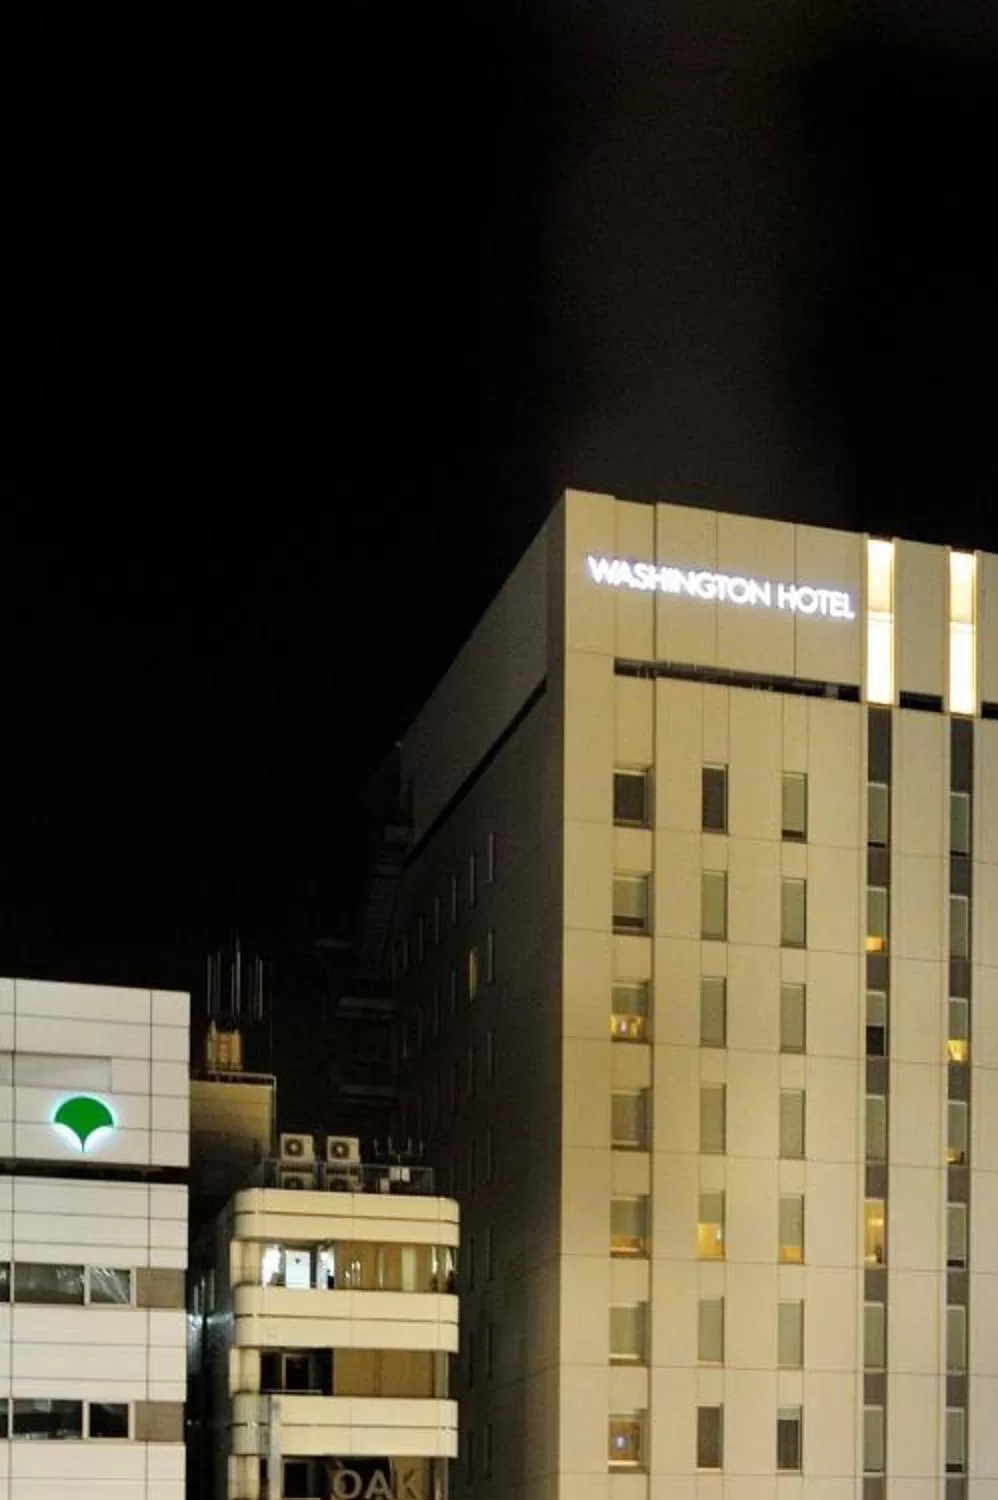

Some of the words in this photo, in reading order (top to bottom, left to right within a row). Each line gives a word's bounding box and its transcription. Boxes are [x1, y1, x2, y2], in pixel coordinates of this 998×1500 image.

[586, 554, 772, 609] WASHINGTON
[777, 583, 856, 620] HOTEL
[333, 1469, 424, 1500] OAK
